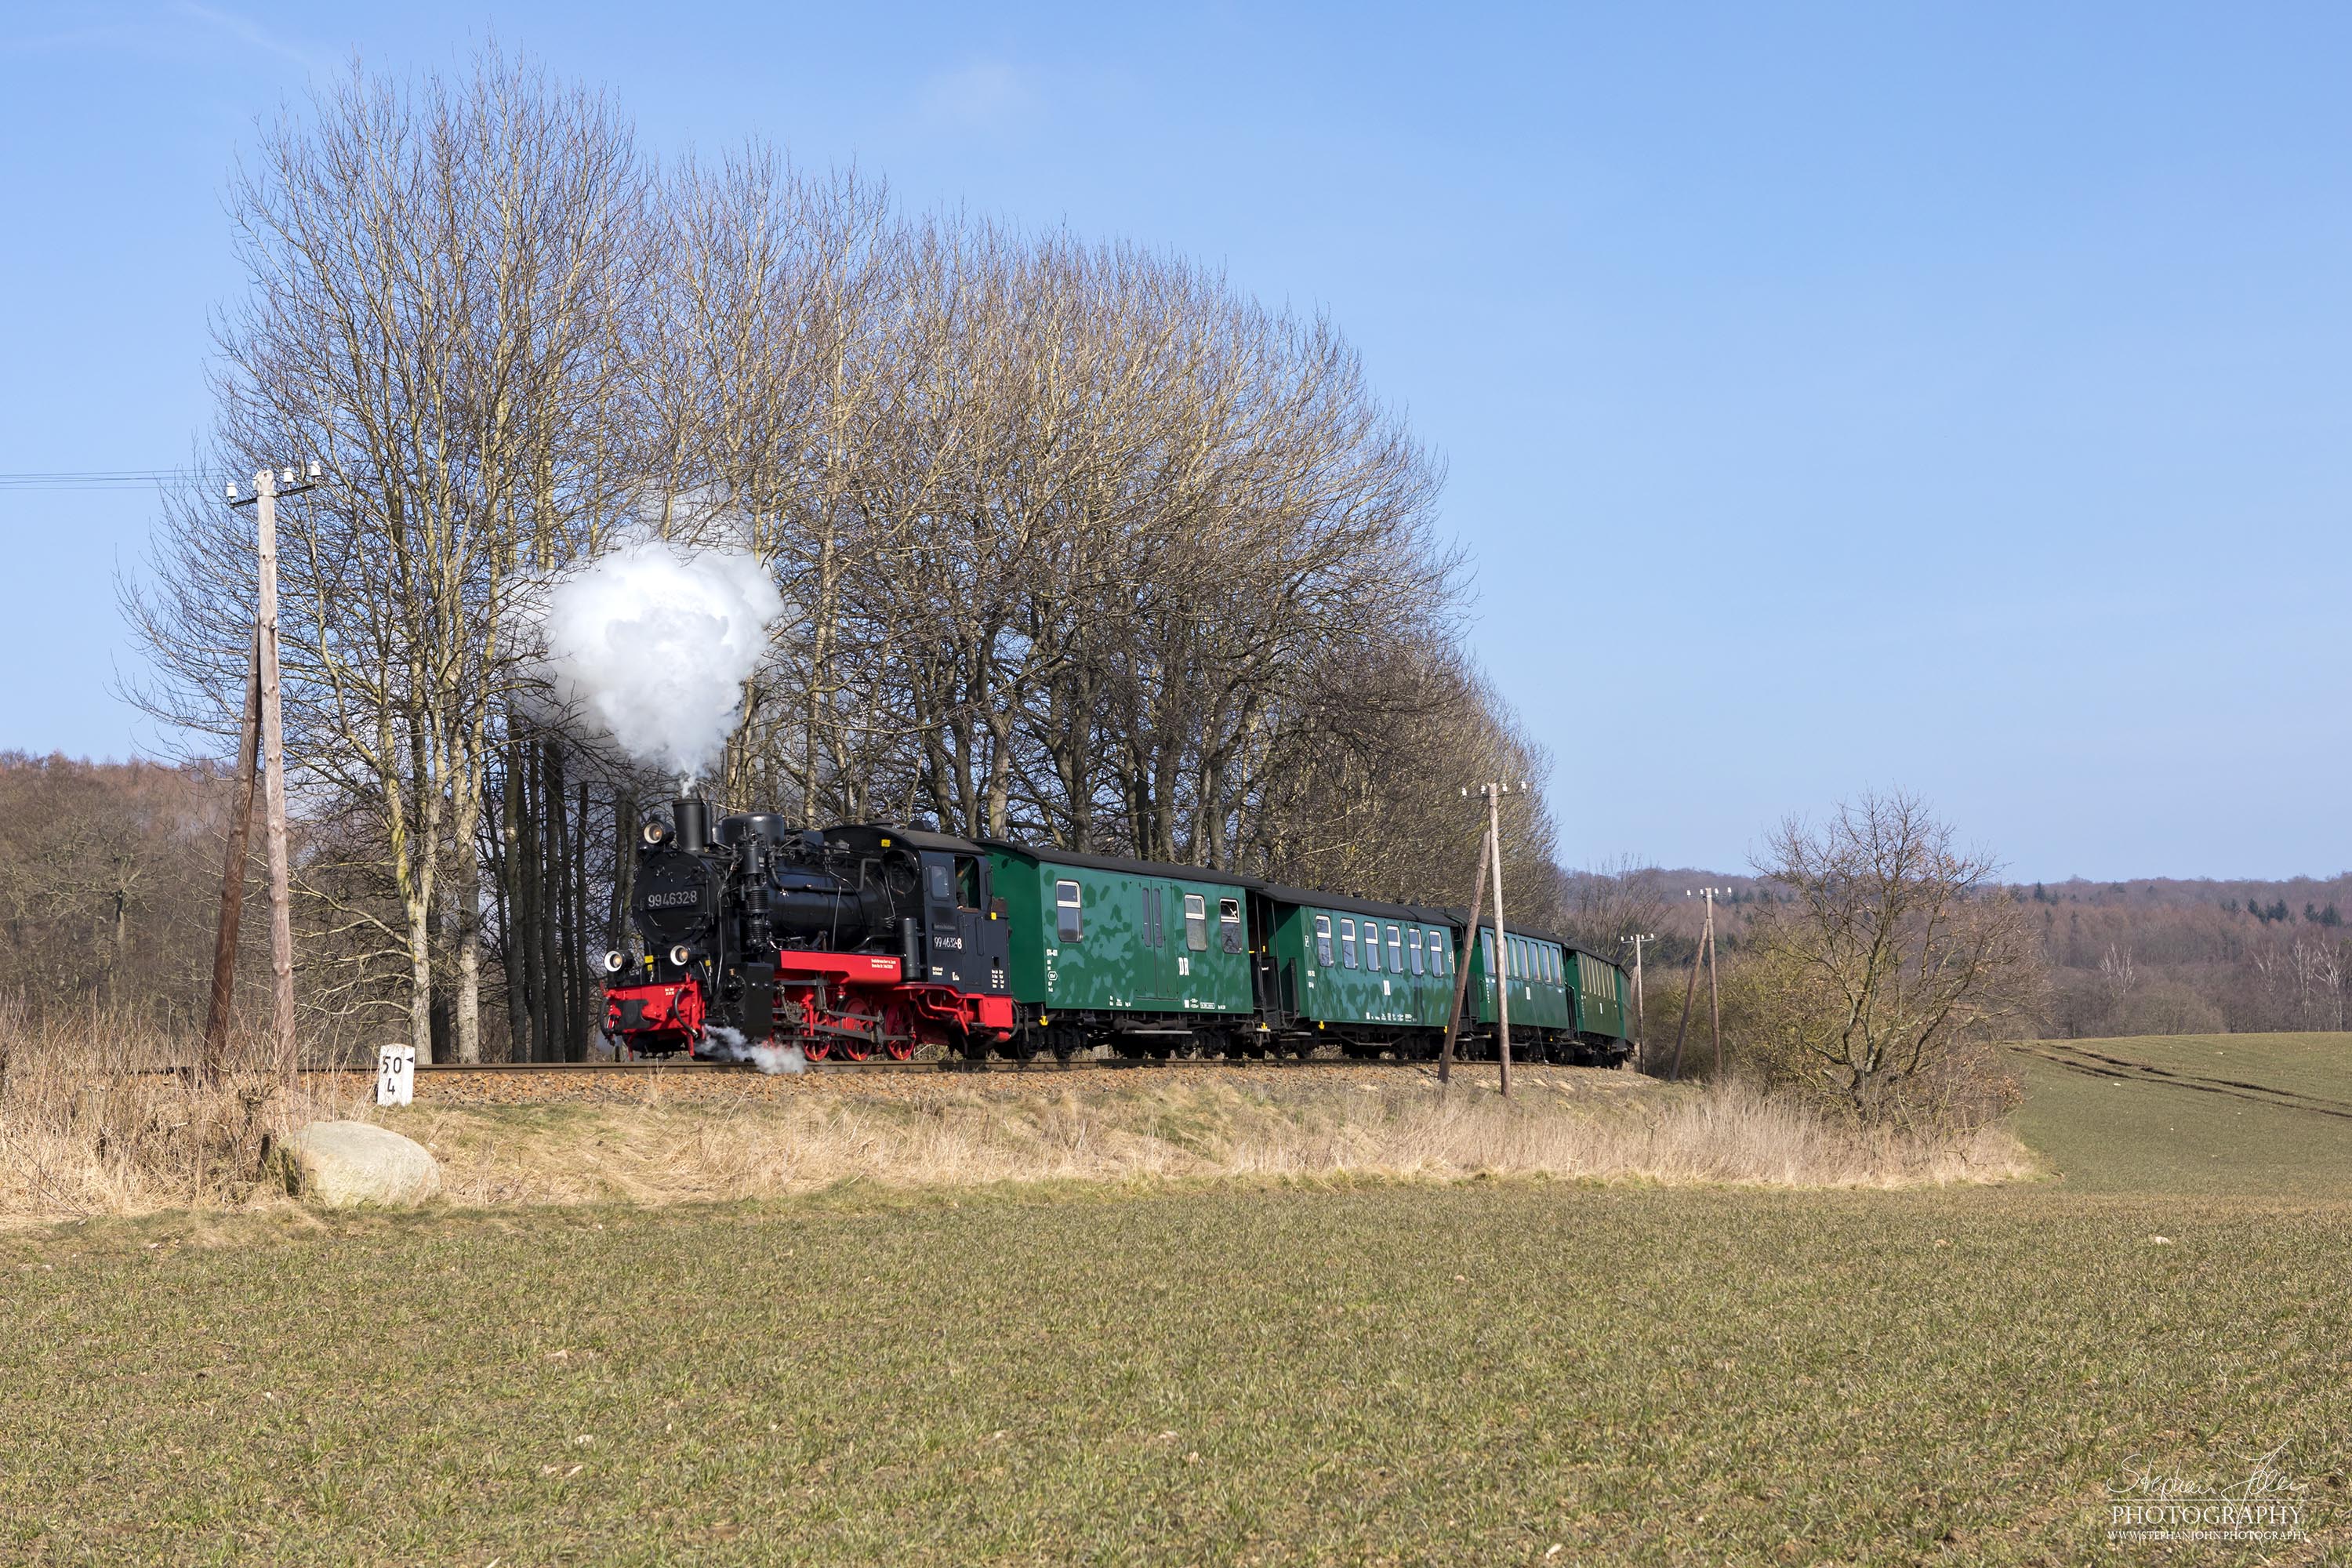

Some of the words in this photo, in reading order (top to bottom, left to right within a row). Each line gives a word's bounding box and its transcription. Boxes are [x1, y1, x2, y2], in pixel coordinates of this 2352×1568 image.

[1178, 957, 1189, 976] DR
[383, 1056, 401, 1073] 50
[387, 1078, 395, 1094] 4
